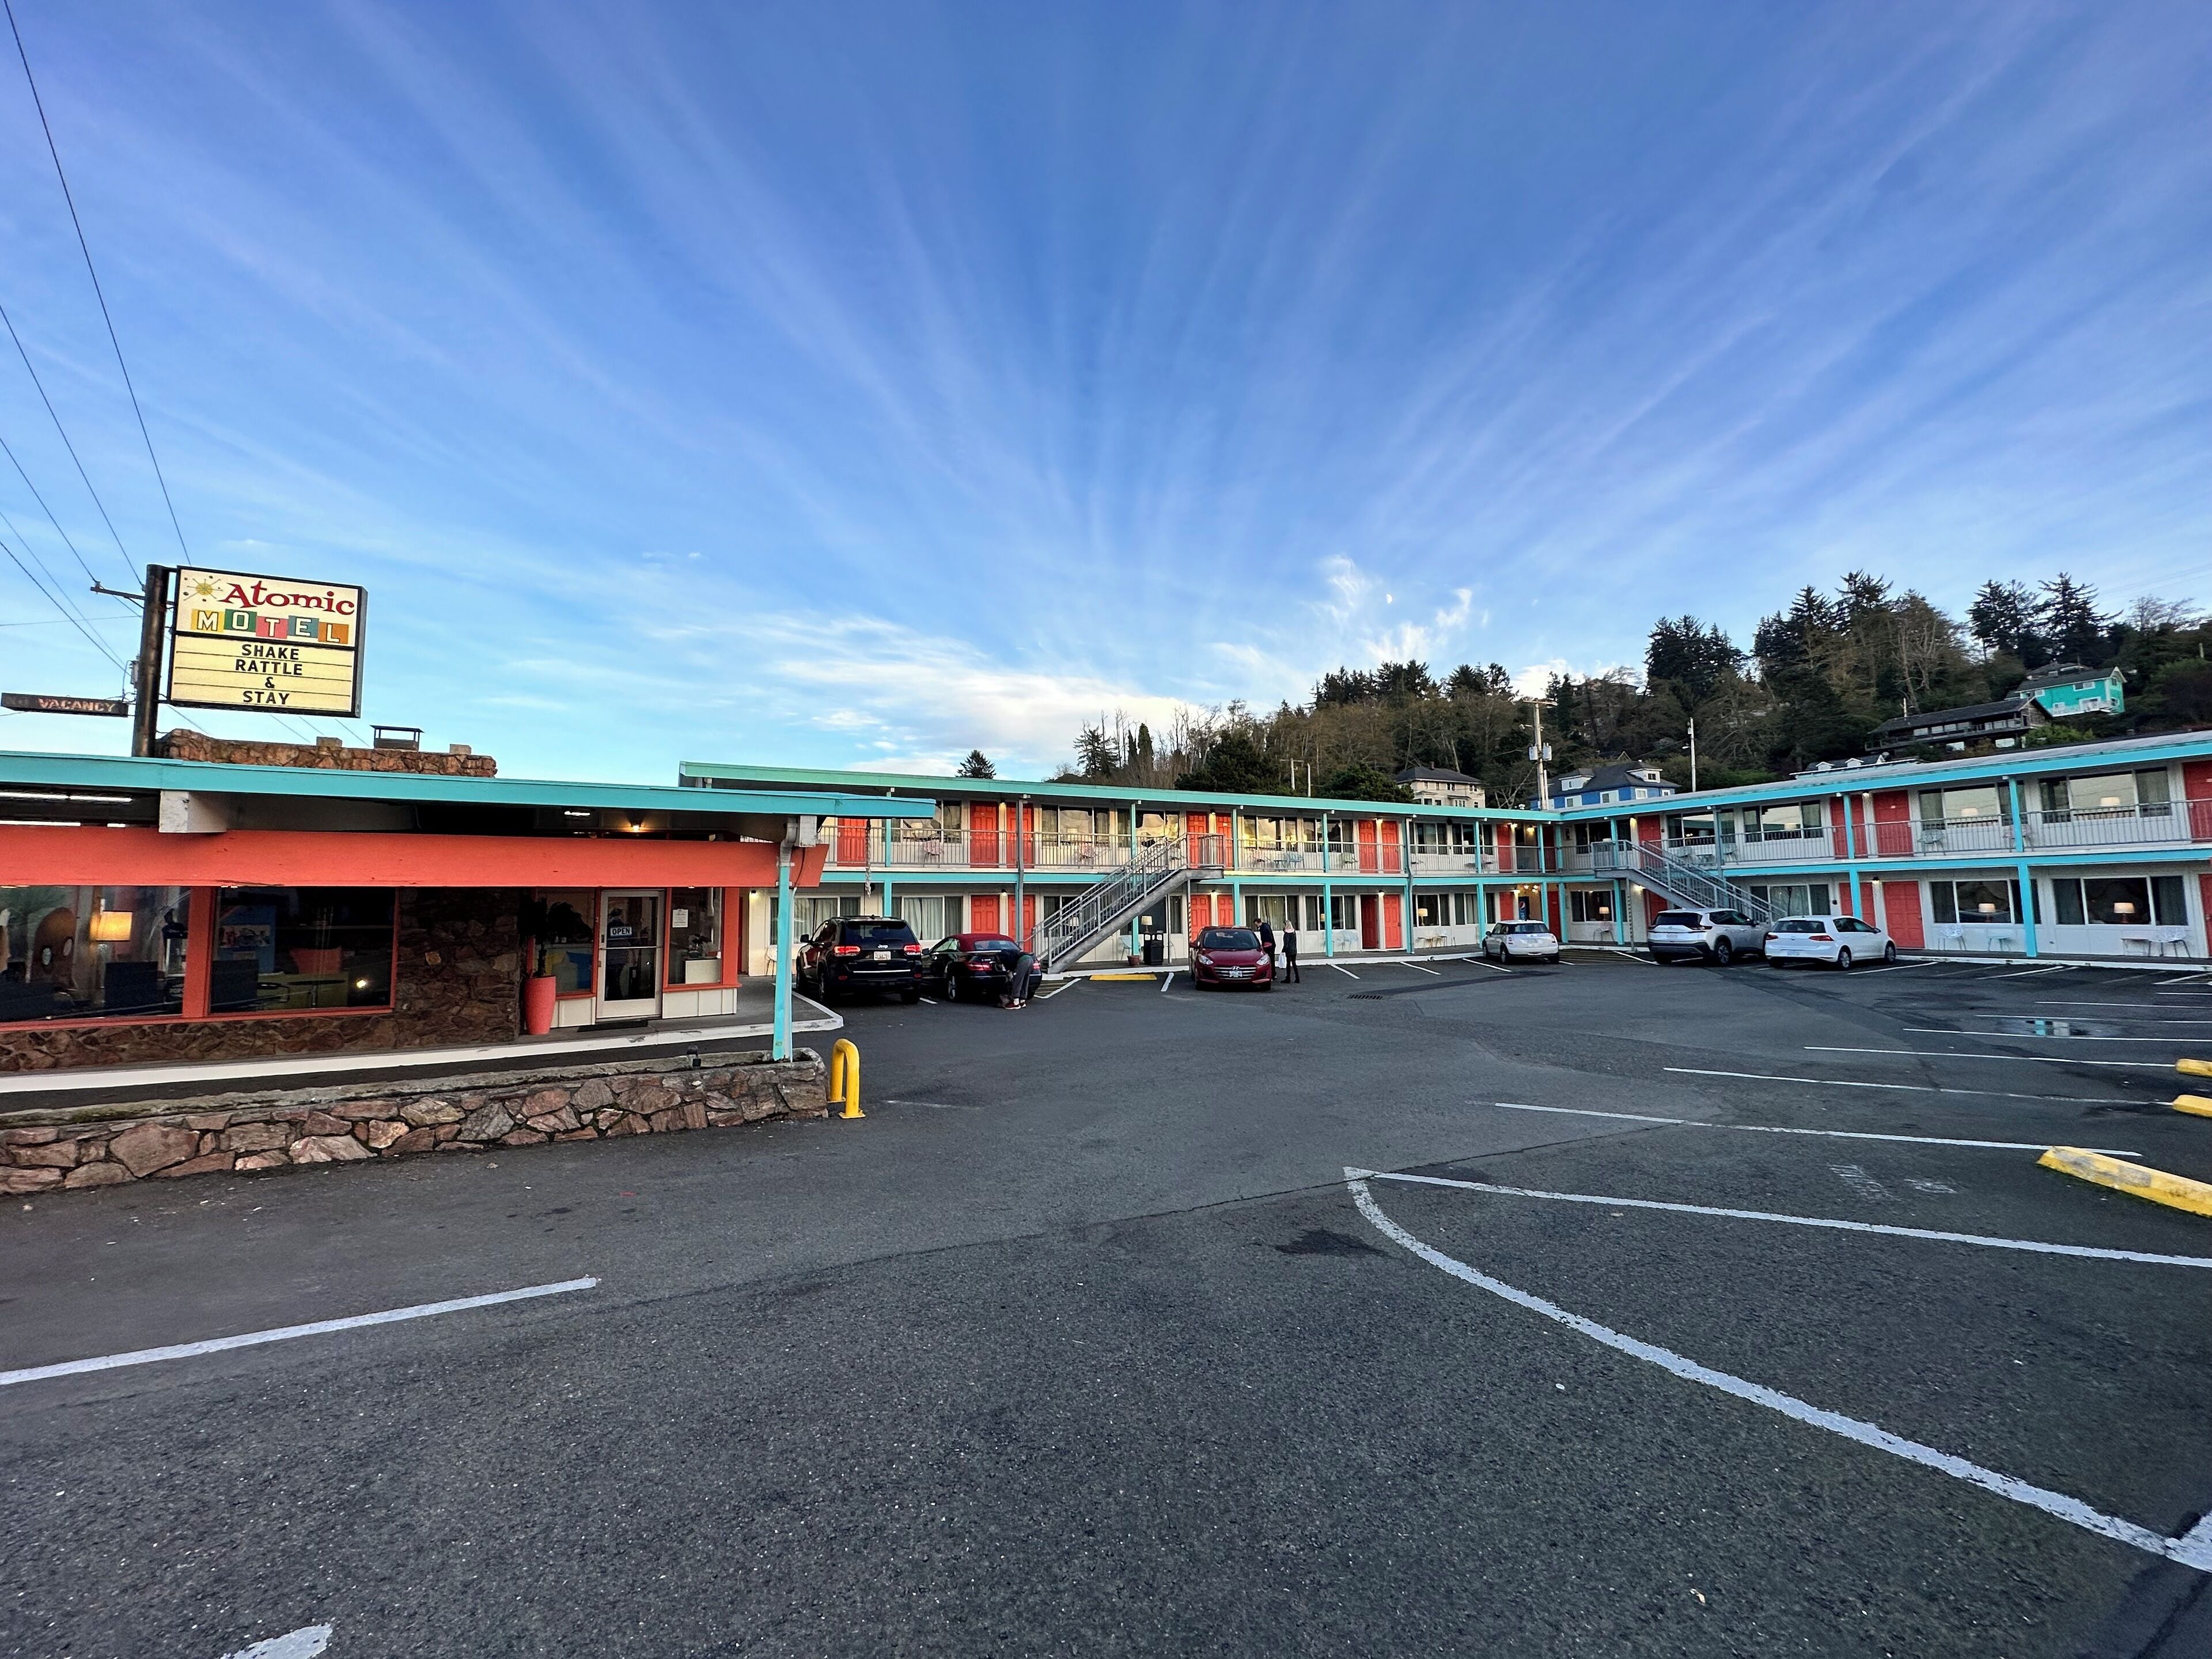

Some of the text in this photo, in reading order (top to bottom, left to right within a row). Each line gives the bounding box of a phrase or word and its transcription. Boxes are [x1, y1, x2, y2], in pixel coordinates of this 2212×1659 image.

[218, 580, 355, 615] Atomic
[196, 610, 341, 643] MOTEL
[241, 644, 300, 660] SHAKE
[235, 659, 302, 676] RATTLE
[264, 676, 275, 689] &
[37, 698, 115, 712] VACANCY
[243, 691, 290, 705] STAY
